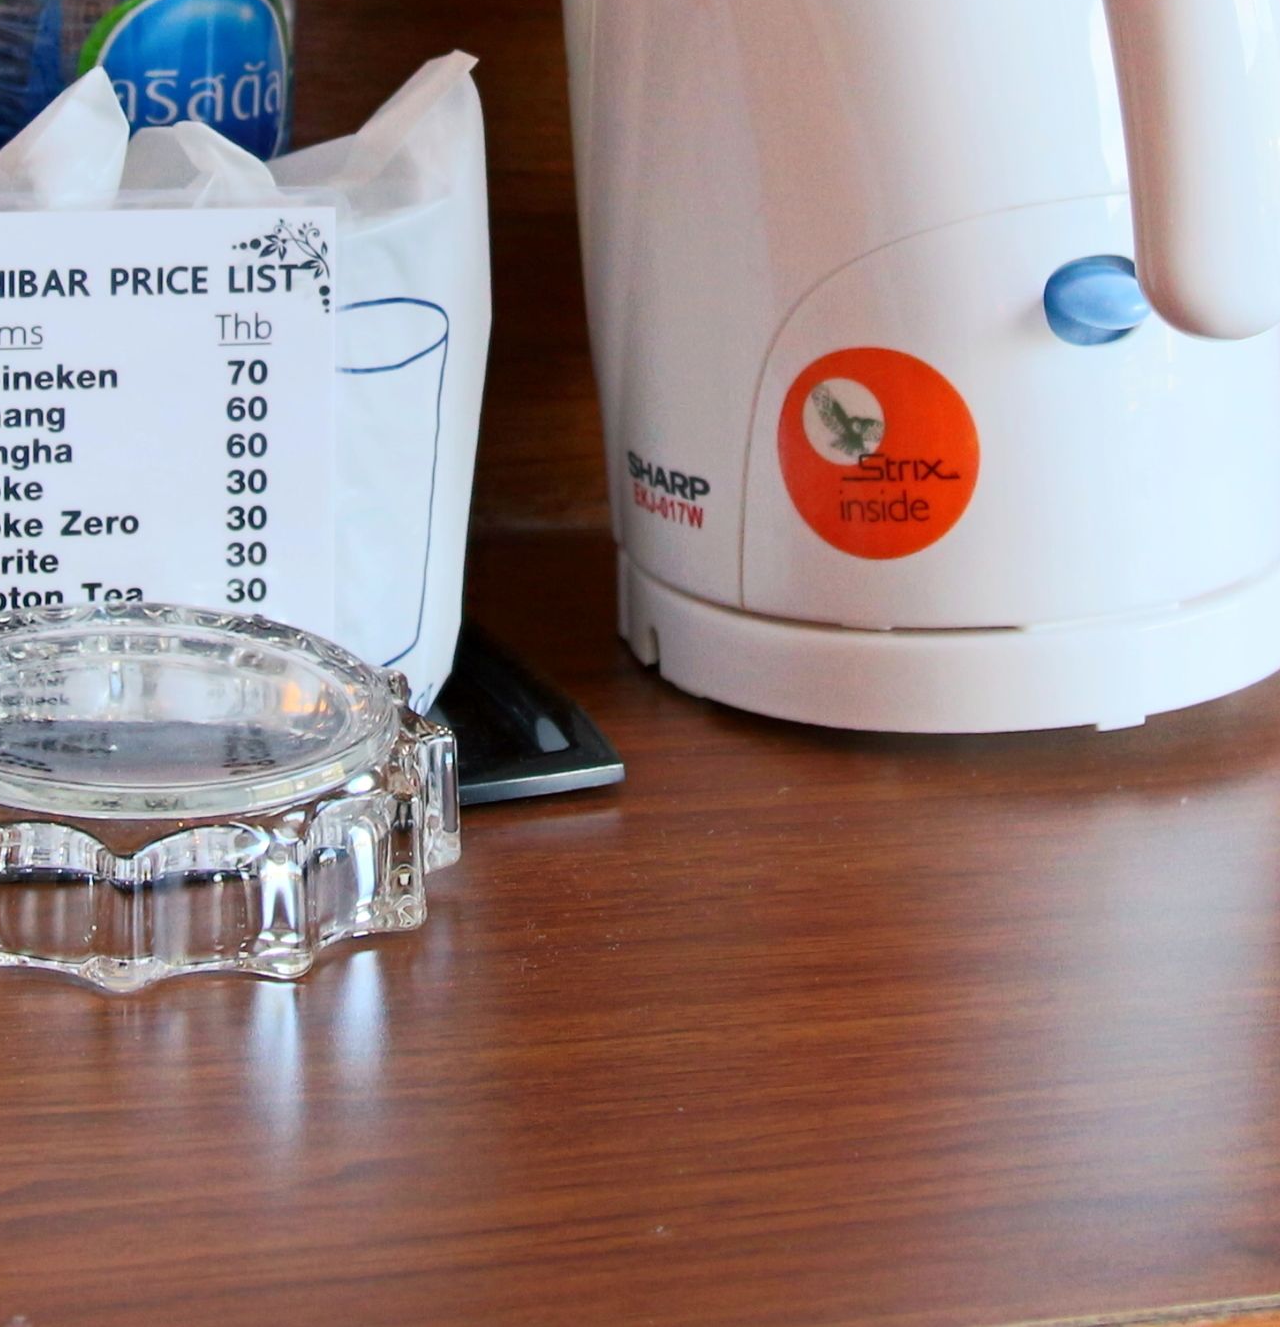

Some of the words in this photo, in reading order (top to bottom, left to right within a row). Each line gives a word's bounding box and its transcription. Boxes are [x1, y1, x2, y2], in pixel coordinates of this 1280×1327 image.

[110, 266, 208, 296] PRICE
[228, 264, 298, 293] LIST
[215, 312, 273, 341] Thb
[227, 359, 269, 385] 70
[226, 396, 268, 422] 60
[226, 432, 268, 459] 60
[627, 449, 710, 502] SHARP
[842, 453, 960, 482] Strix
[226, 469, 268, 495] 30
[840, 489, 930, 523] inside
[60, 510, 140, 536] Zero
[226, 505, 268, 531] 30
[226, 541, 268, 567] 30
[81, 582, 144, 603] Tea
[225, 577, 268, 604] 30
